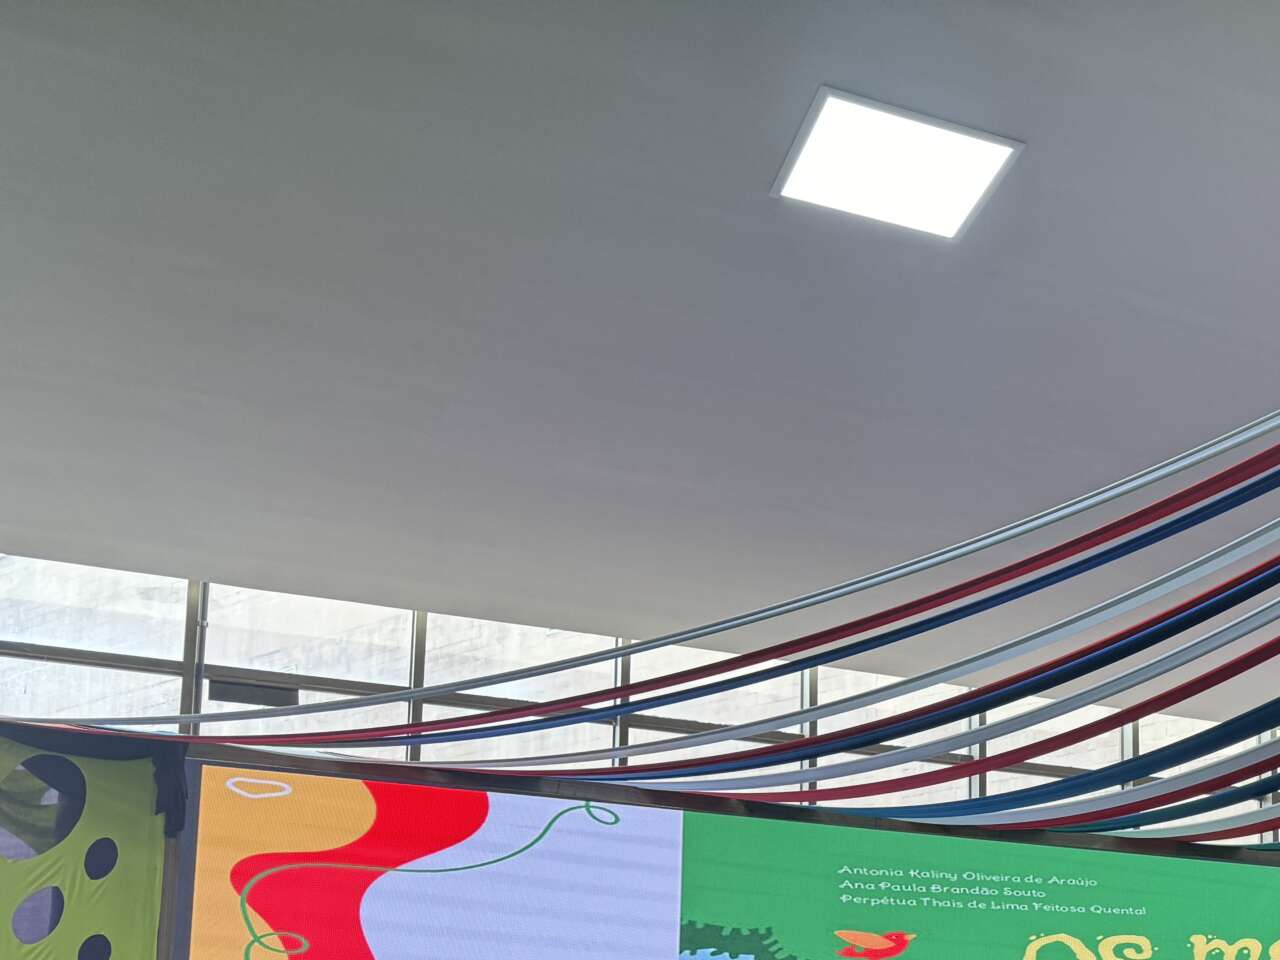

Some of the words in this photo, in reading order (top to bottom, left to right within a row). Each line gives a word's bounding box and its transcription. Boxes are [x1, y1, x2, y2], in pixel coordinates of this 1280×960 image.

[908, 869, 958, 881] Kaliny
[962, 871, 1021, 883] Oliveira
[1024, 874, 1043, 884] de
[1047, 875, 1098, 888] Araújo
[838, 880, 876, 890] Ana
[878, 881, 927, 893] Paula
[929, 884, 999, 896] Brandão
[1003, 887, 1047, 898] Souto
[839, 894, 918, 907] Perpétua
[967, 900, 987, 909] de
[990, 901, 1029, 911] Lima
[1032, 902, 1086, 913] Feitosa
[1089, 904, 1147, 915] Quental
